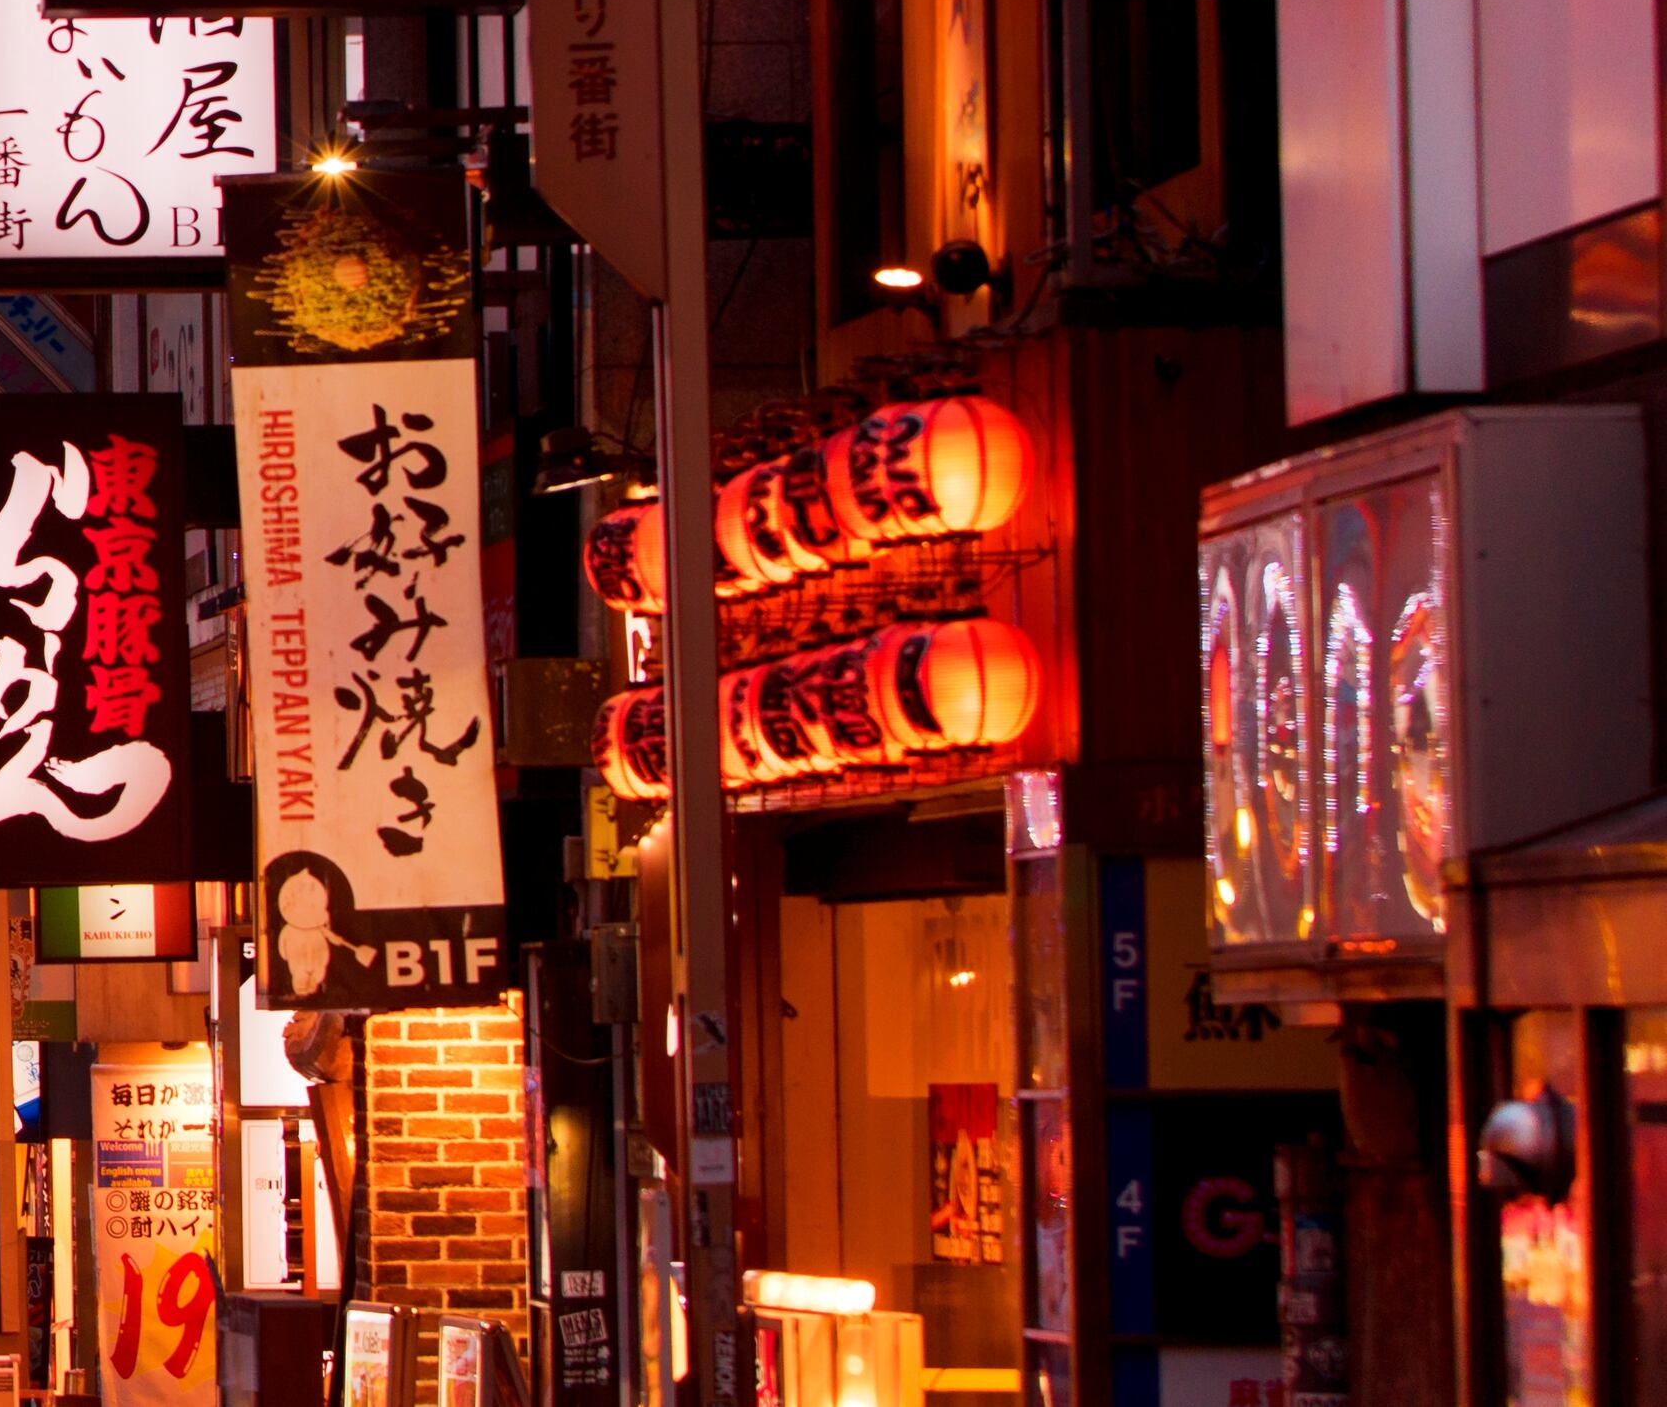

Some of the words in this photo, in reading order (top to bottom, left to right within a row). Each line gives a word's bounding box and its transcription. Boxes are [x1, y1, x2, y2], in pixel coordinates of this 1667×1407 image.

[259, 410, 304, 588] HIROSHIMA
[82, 432, 164, 737] 東京豚骨
[327, 402, 480, 858] お好み焼き
[269, 608, 309, 743] TEPPAN
[277, 743, 315, 822] YAKI
[83, 930, 153, 941] KABUKICHO
[385, 939, 498, 986] B1F
[100, 1140, 144, 1152] Welcome
[100, 1165, 135, 1177] English
[138, 1167, 161, 1176] menu
